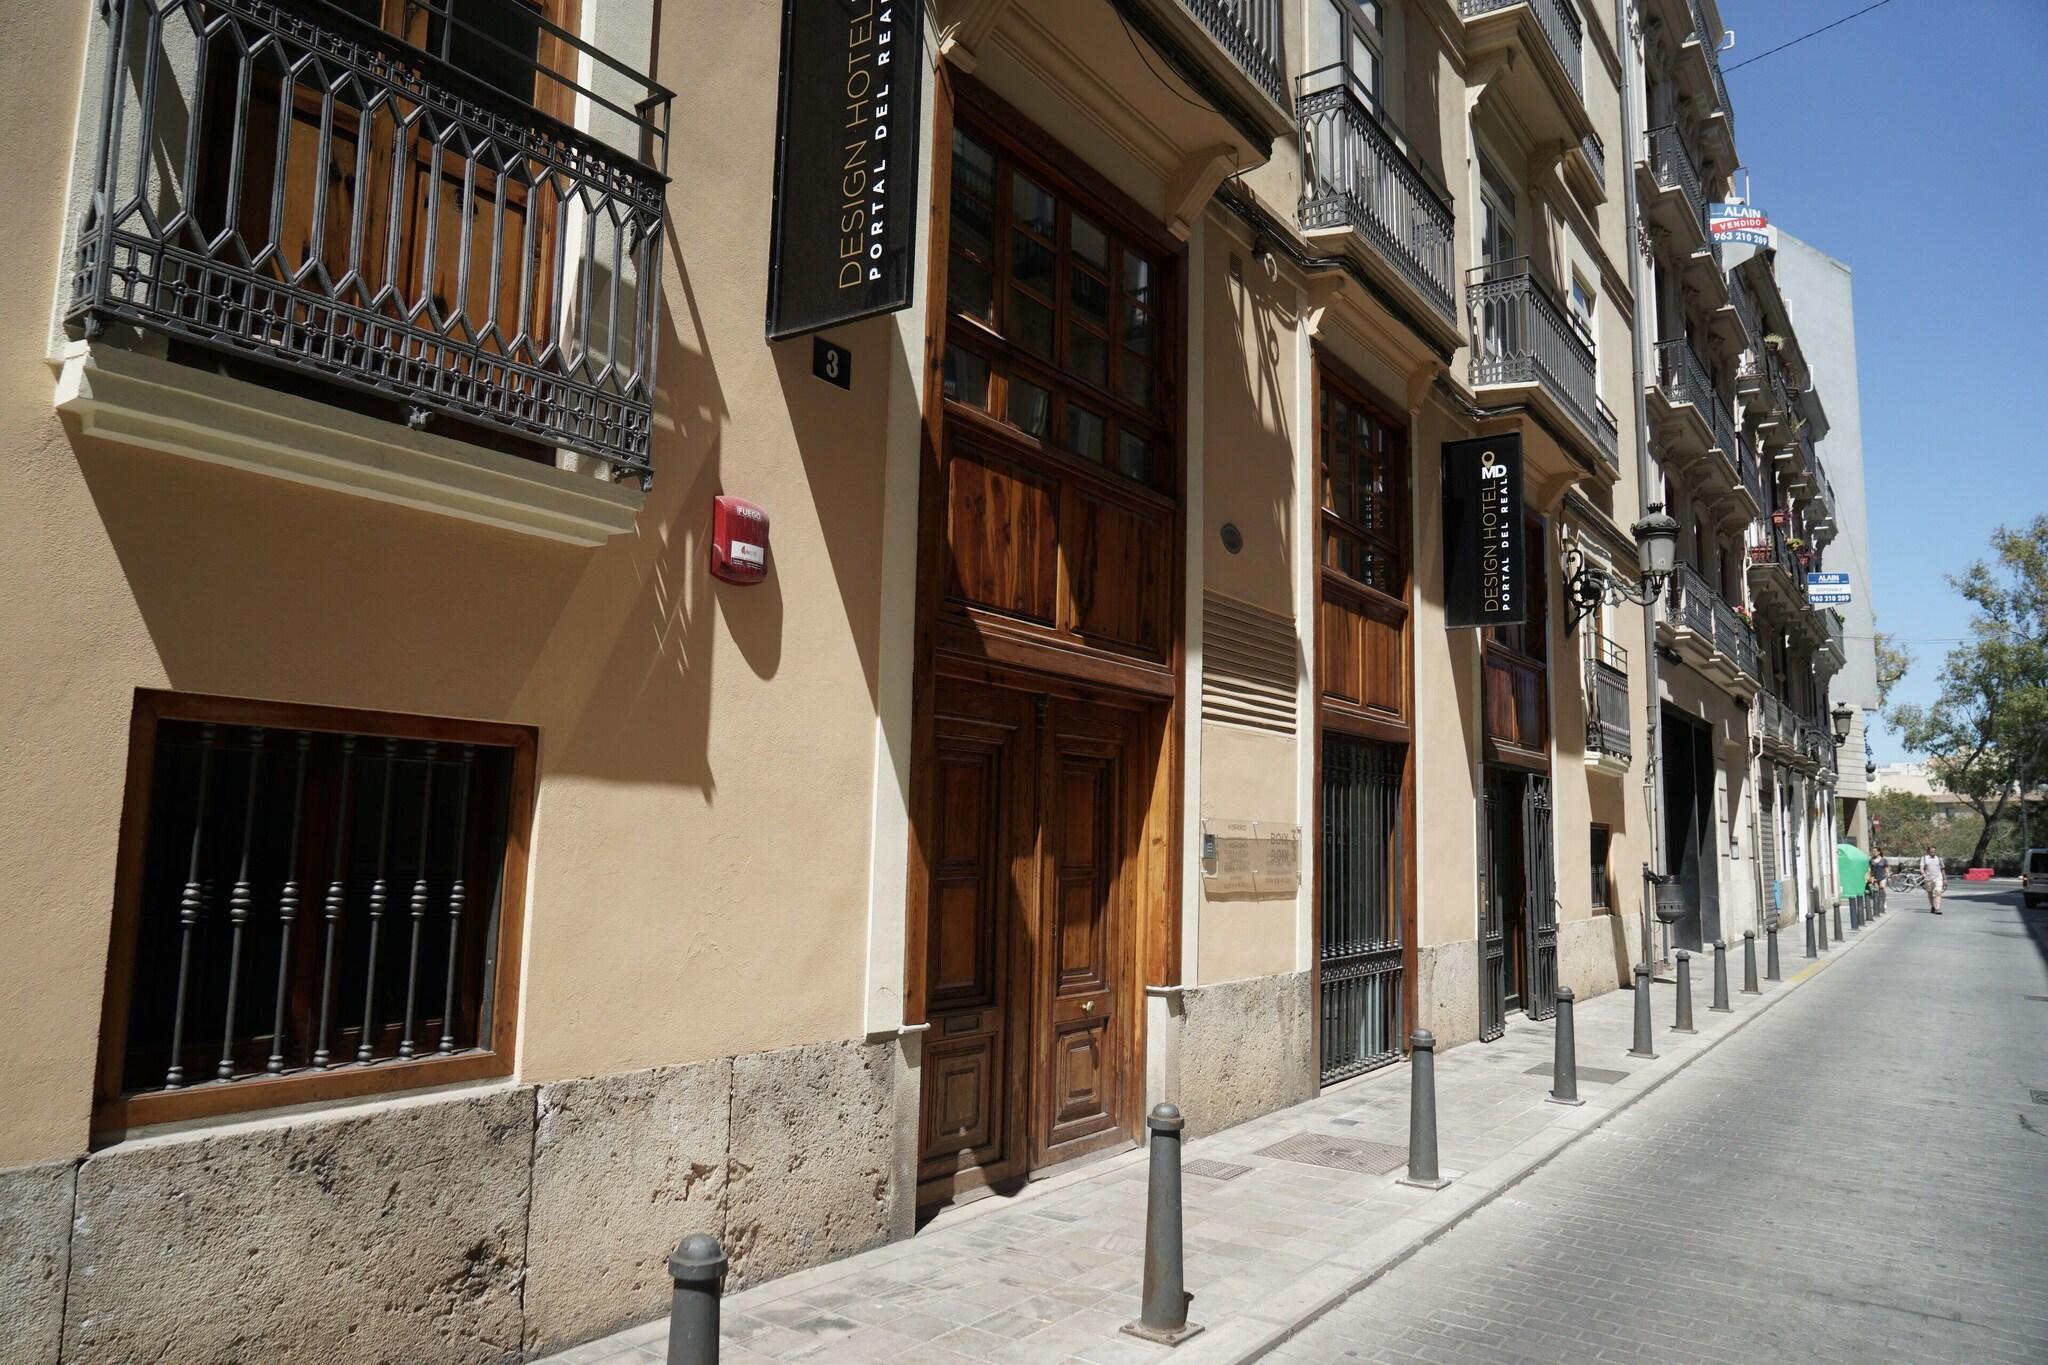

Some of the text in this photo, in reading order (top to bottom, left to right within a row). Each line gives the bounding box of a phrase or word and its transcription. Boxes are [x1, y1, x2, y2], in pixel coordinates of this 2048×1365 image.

[839, 0, 873, 289] DESIGN HOTEL
[869, 0, 893, 281] PORTAL DEL REA
[1724, 206, 1761, 218] ALAIN
[1720, 219, 1761, 230] VENDIDO
[1714, 232, 1767, 246] 963 210 289
[826, 350, 838, 378] 3
[1481, 465, 1506, 480] MD
[737, 506, 760, 519] FUEGO
[1482, 480, 1499, 612] DESIGN HOTEL
[1500, 478, 1510, 611] PORTAL DEL REAL
[1270, 832, 1289, 845] BOIX
